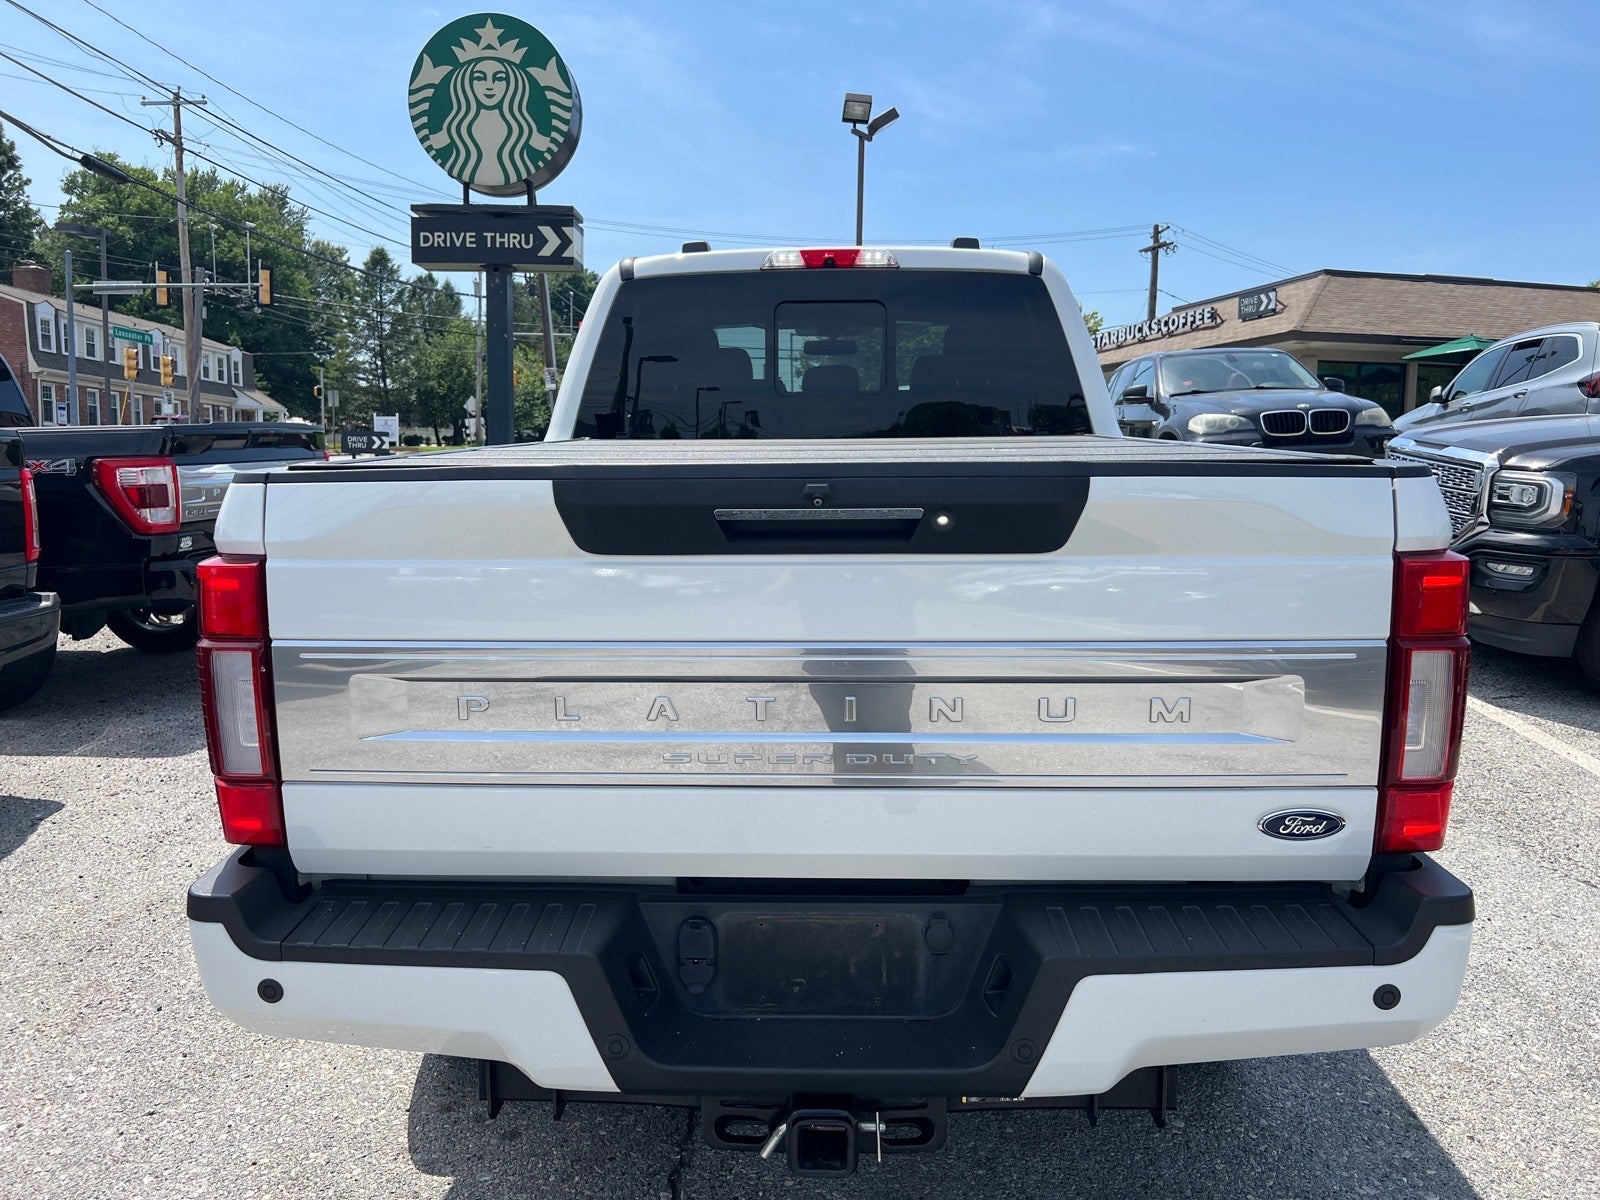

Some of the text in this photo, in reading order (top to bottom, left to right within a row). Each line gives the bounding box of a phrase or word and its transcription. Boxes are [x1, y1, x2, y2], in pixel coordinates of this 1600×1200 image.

[419, 232, 534, 249] DRIVE THRU
[1240, 295, 1258, 307] DRIVE
[1240, 305, 1257, 315] THRU
[115, 328, 143, 340] Lancaster
[1090, 307, 1213, 348] STARBUCKS COFFEE
[457, 695, 1192, 723] PLATINUM
[662, 752, 978, 766] SUPER DUTY
[1280, 815, 1327, 834] Ford
